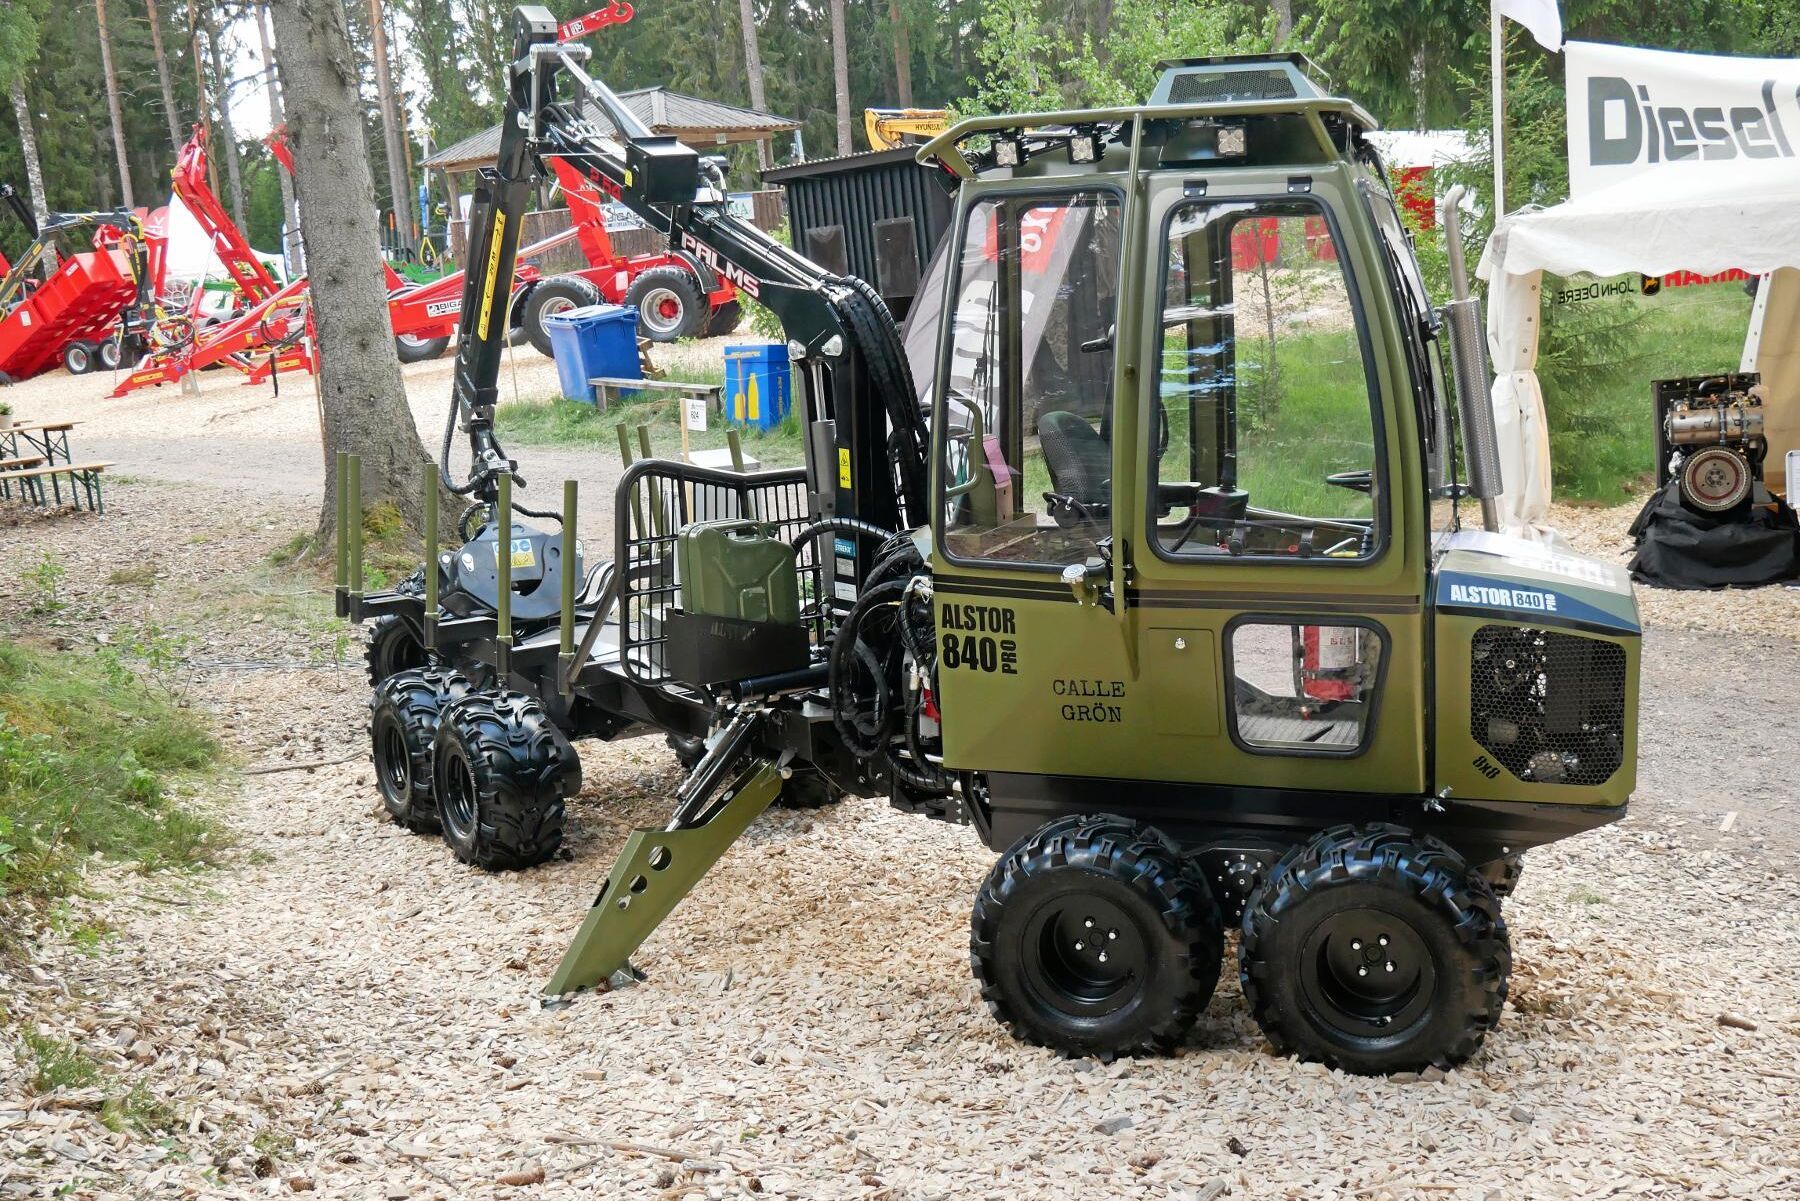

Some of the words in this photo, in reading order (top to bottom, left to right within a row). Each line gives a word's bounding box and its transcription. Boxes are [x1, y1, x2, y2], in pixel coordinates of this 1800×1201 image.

[1587, 77, 1795, 166] Diesel
[681, 231, 760, 298] PALMS
[1450, 584, 1512, 607] ALSTOR
[1515, 592, 1542, 609] 840
[1546, 593, 1558, 612] PRO
[941, 603, 1016, 635] ALSTOR
[942, 633, 998, 673] 840
[1000, 639, 1018, 675] PRO
[1052, 679, 1126, 697] CALLE
[1061, 702, 1122, 722] GRÖN
[1472, 755, 1501, 779] 8x8
